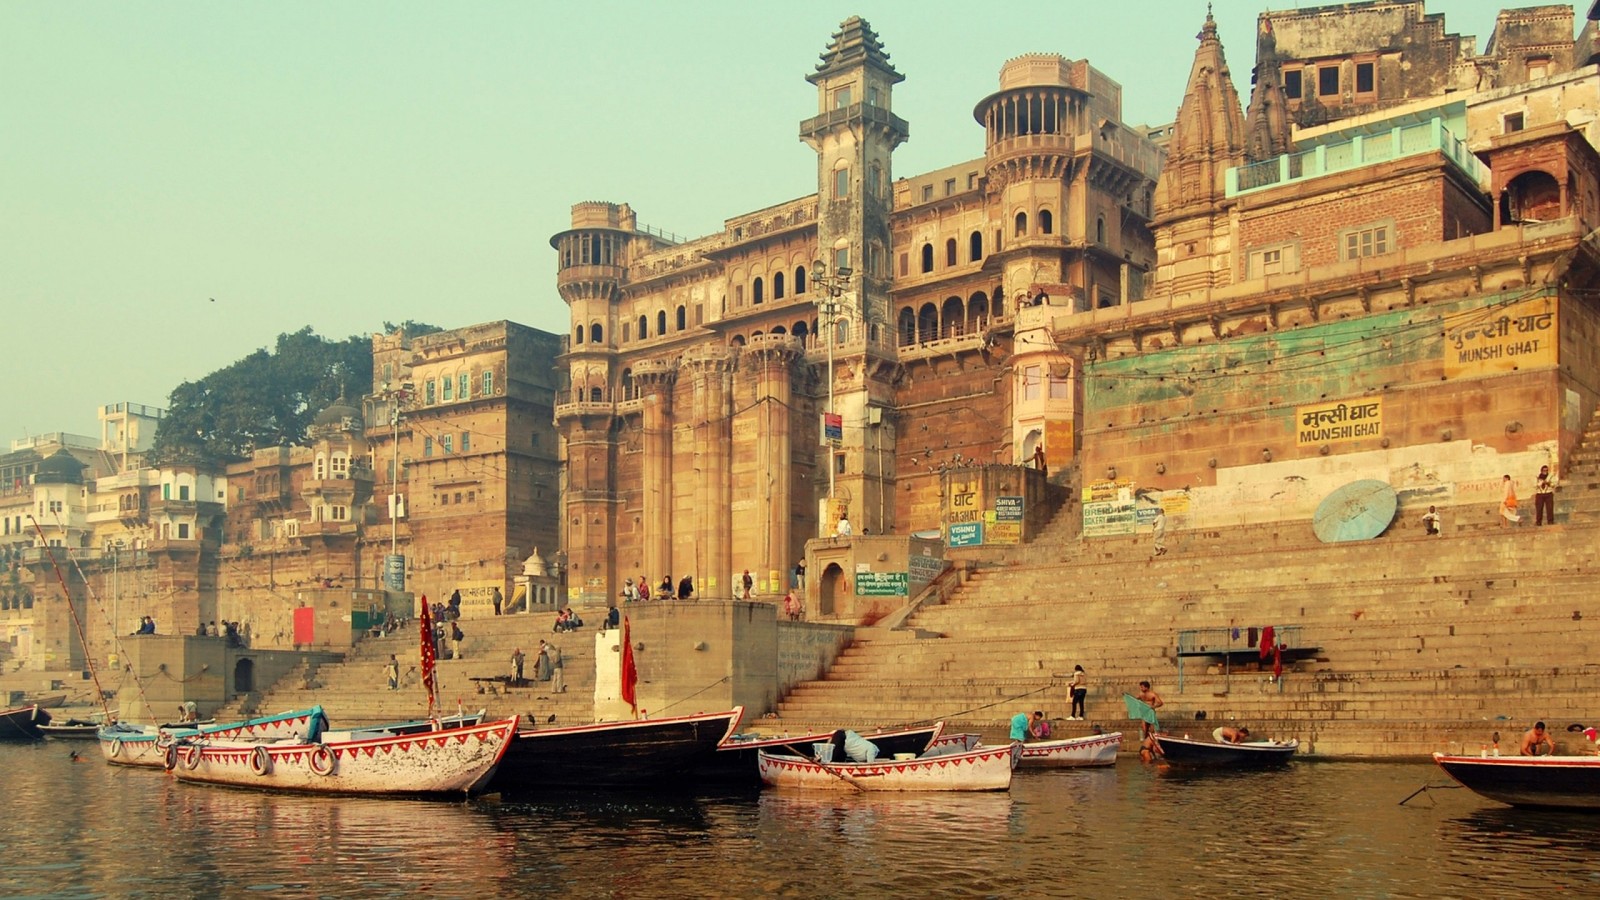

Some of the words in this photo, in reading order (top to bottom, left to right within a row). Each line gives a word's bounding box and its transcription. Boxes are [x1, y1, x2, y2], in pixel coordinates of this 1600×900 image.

[1517, 313, 1554, 332] घाट
[1459, 344, 1502, 363] MUNSHI
[1506, 340, 1539, 356] GHAT
[1302, 404, 1348, 428] मुन्सी
[1349, 403, 1379, 420] घाट
[1300, 425, 1352, 442] MUNSHI
[1354, 422, 1380, 437] GHAT
[951, 525, 976, 534] VISHNU
